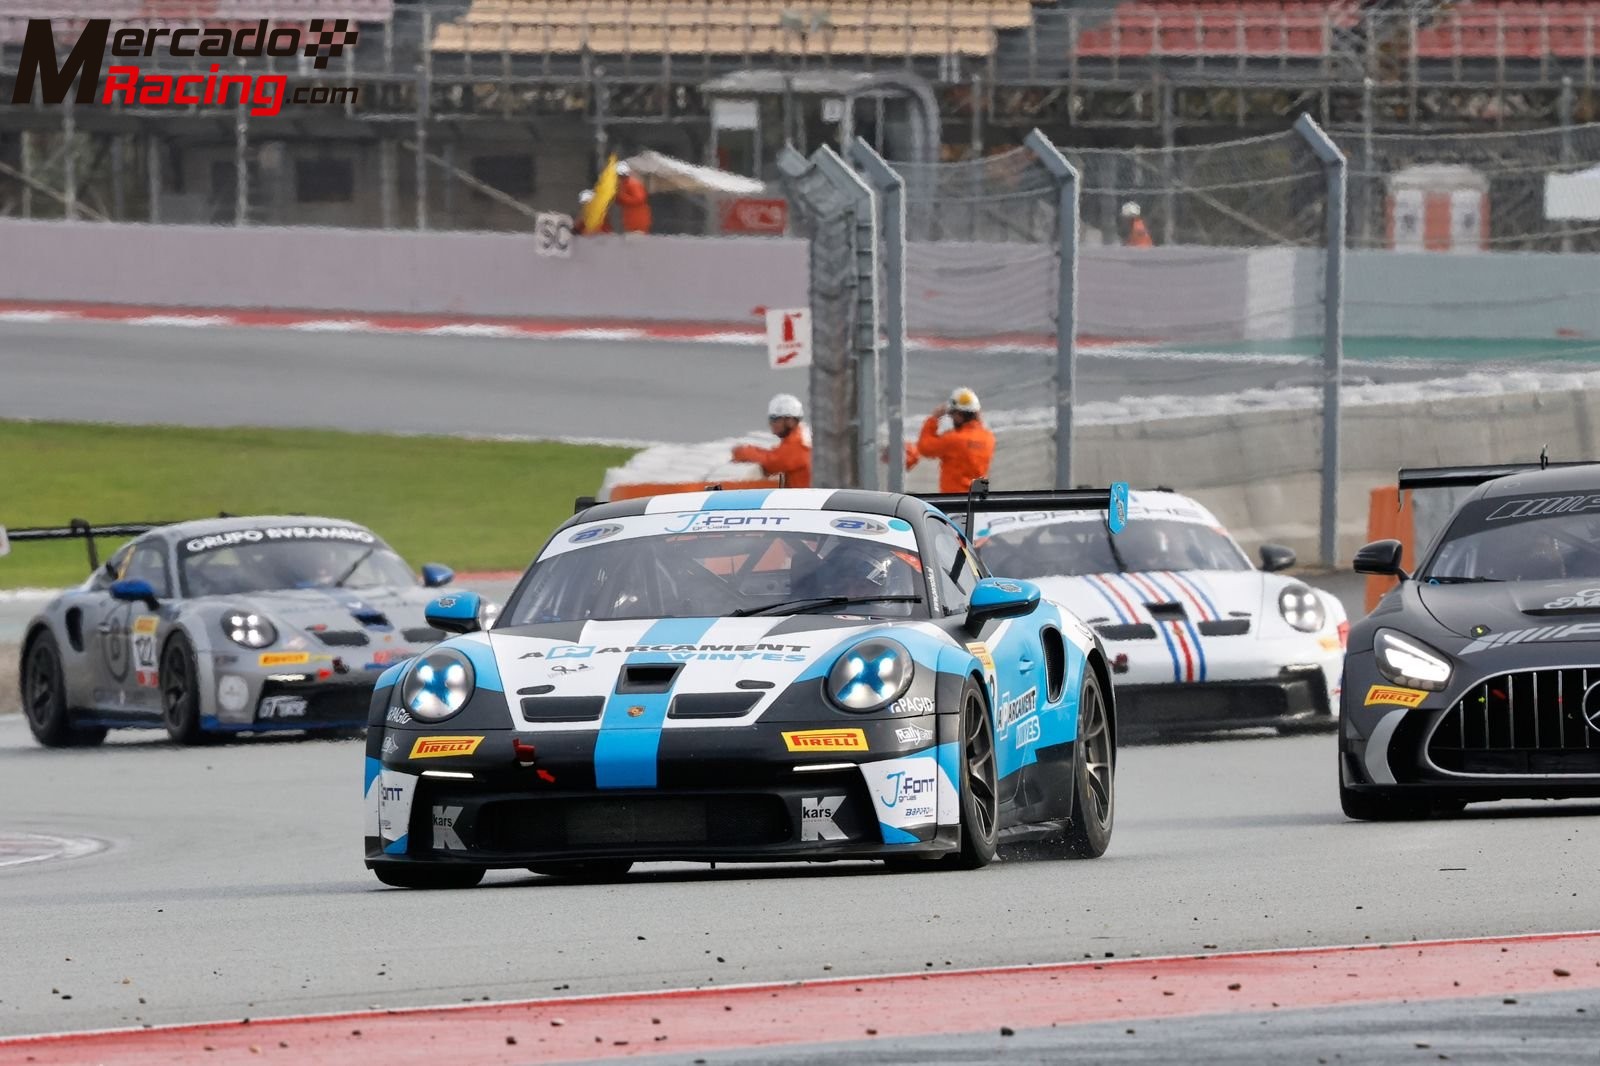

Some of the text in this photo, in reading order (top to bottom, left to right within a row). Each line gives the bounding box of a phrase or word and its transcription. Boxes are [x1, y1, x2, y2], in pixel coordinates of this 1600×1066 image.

[542, 219, 571, 250] SC
[186, 530, 264, 551] GRUPO
[668, 652, 807, 662] VINYES
[1370, 689, 1420, 703] PIRELLI
[898, 697, 933, 712] PAGID
[791, 733, 859, 746] PIRELLI
[416, 740, 475, 753] PIRELLI
[803, 806, 831, 819] kars
[433, 814, 453, 827] kars
